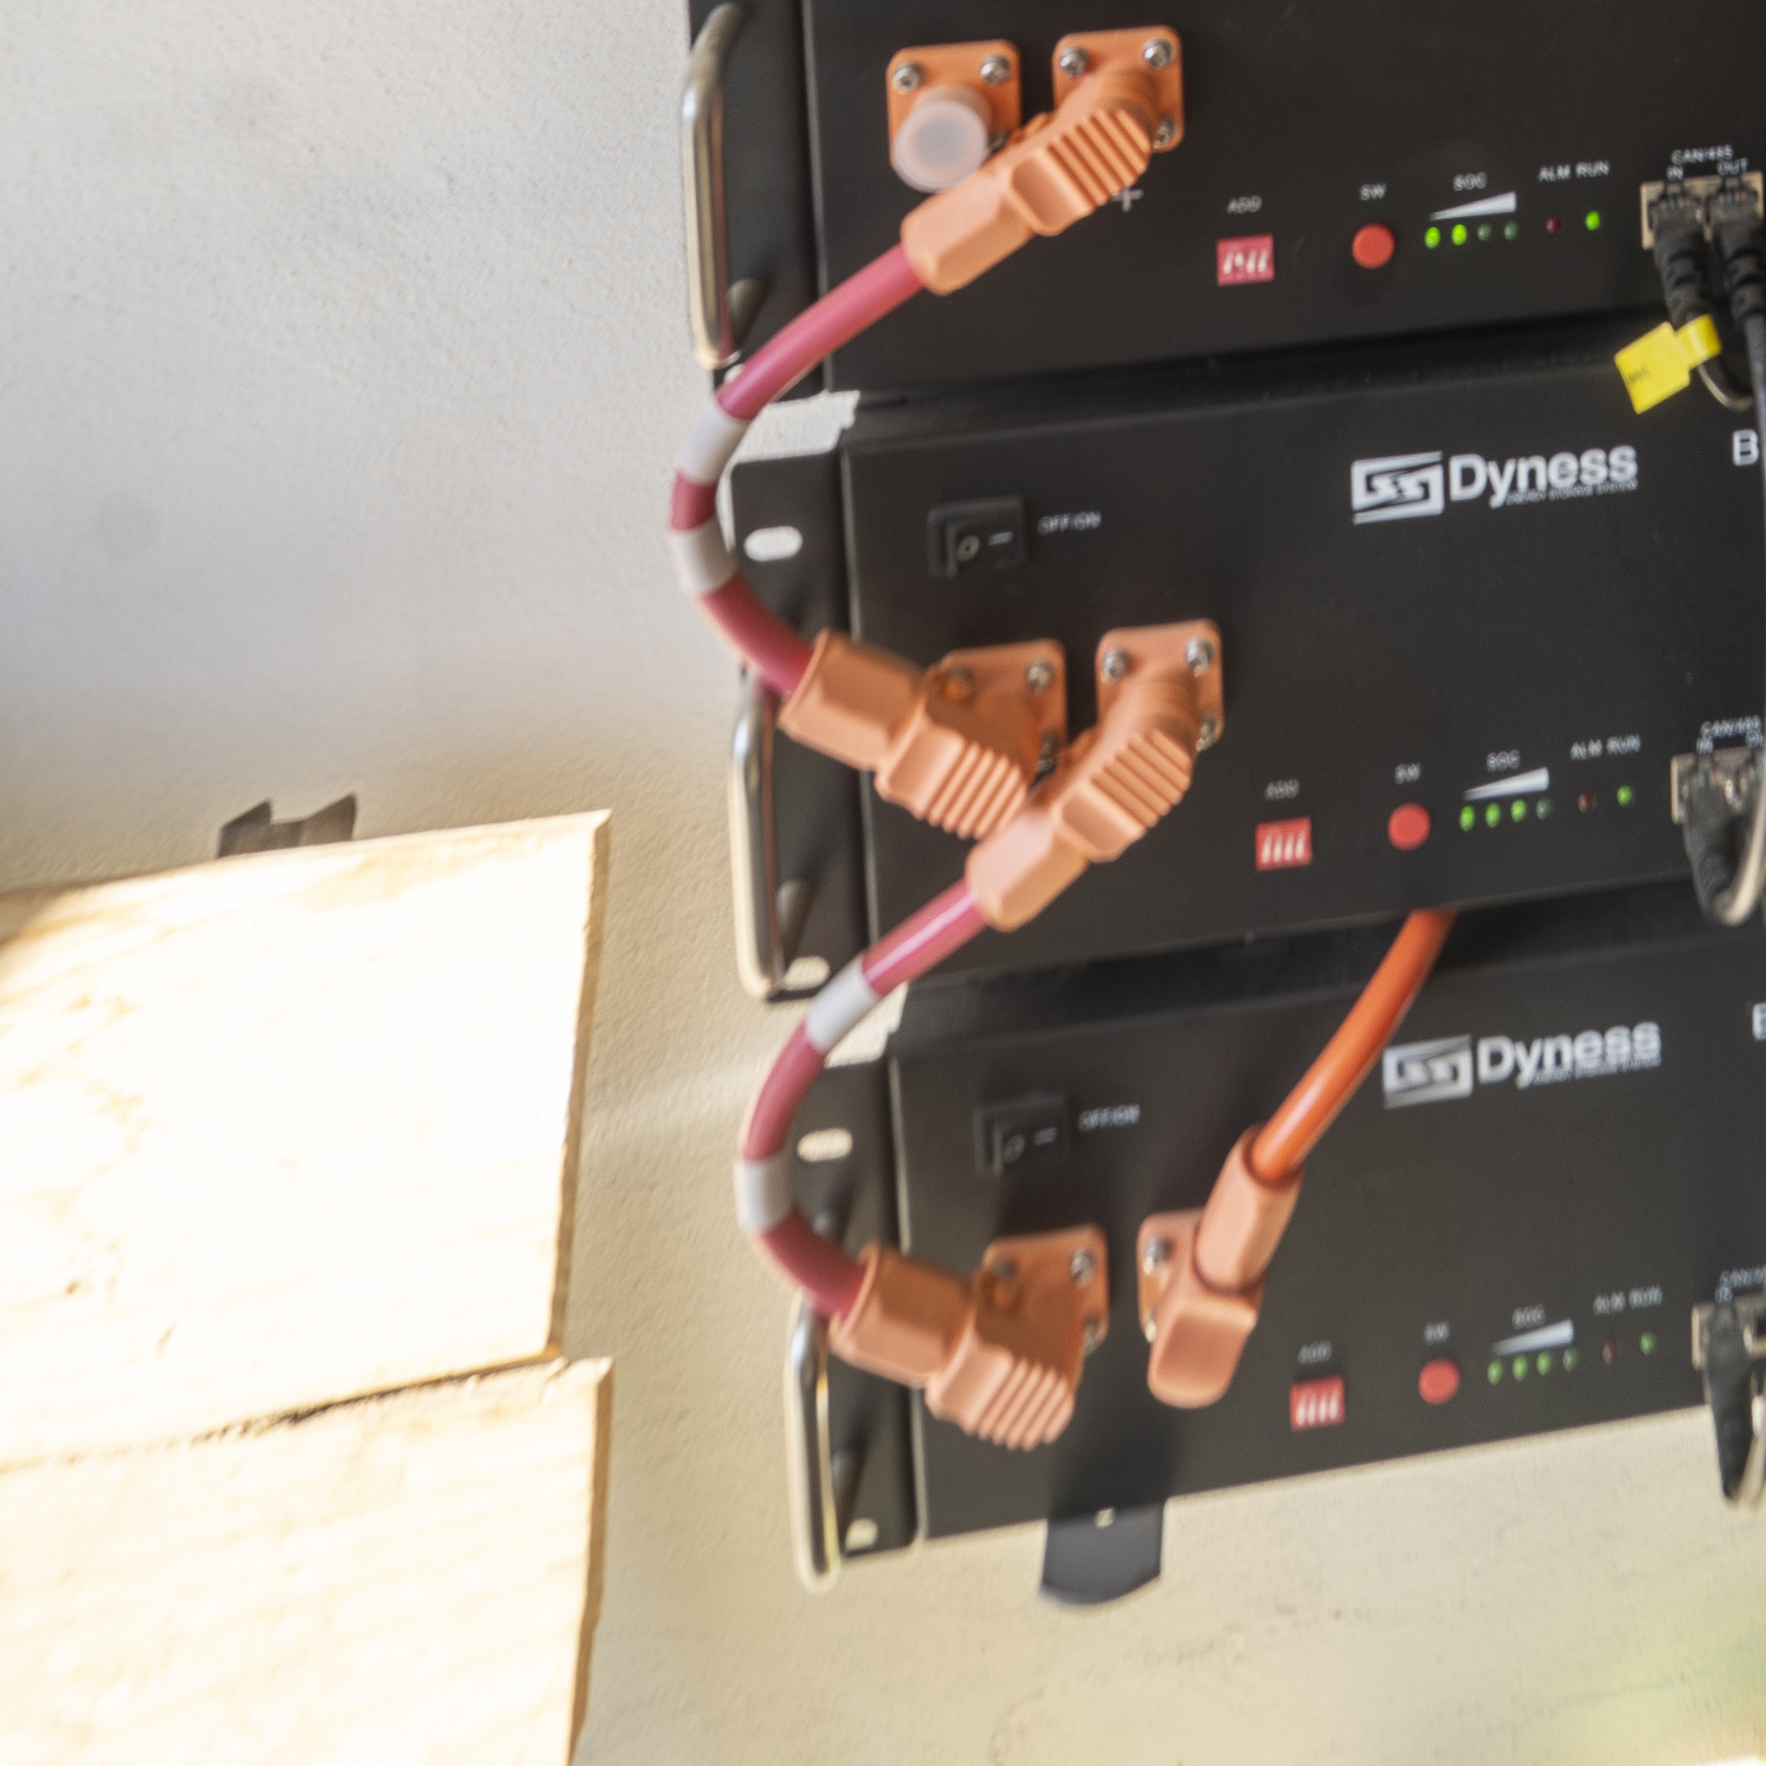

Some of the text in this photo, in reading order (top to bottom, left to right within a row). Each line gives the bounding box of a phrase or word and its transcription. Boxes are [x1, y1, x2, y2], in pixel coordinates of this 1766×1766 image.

[1359, 182, 1388, 201] SW
[1449, 445, 1639, 509] Dyness
[1477, 1020, 1663, 1091] Dyness
